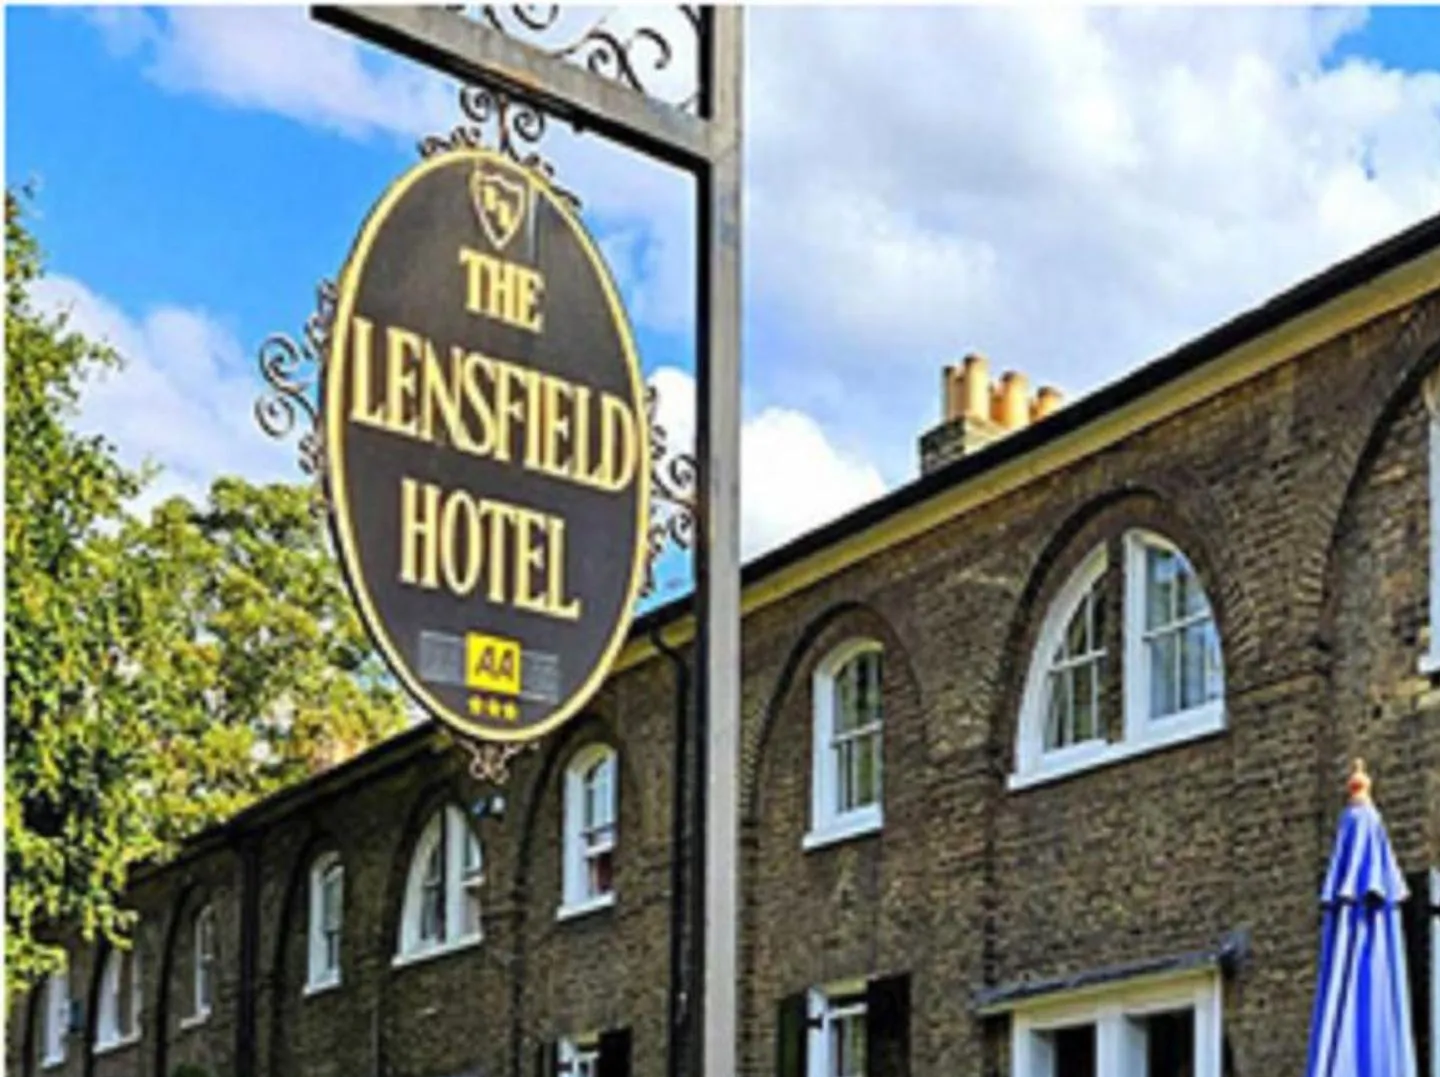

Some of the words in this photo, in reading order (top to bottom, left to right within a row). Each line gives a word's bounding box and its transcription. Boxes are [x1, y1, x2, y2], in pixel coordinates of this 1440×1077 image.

[460, 248, 544, 333] THE
[350, 316, 636, 492] LENSFIELD
[400, 479, 580, 619] HOTEL
[474, 645, 514, 681] AA
